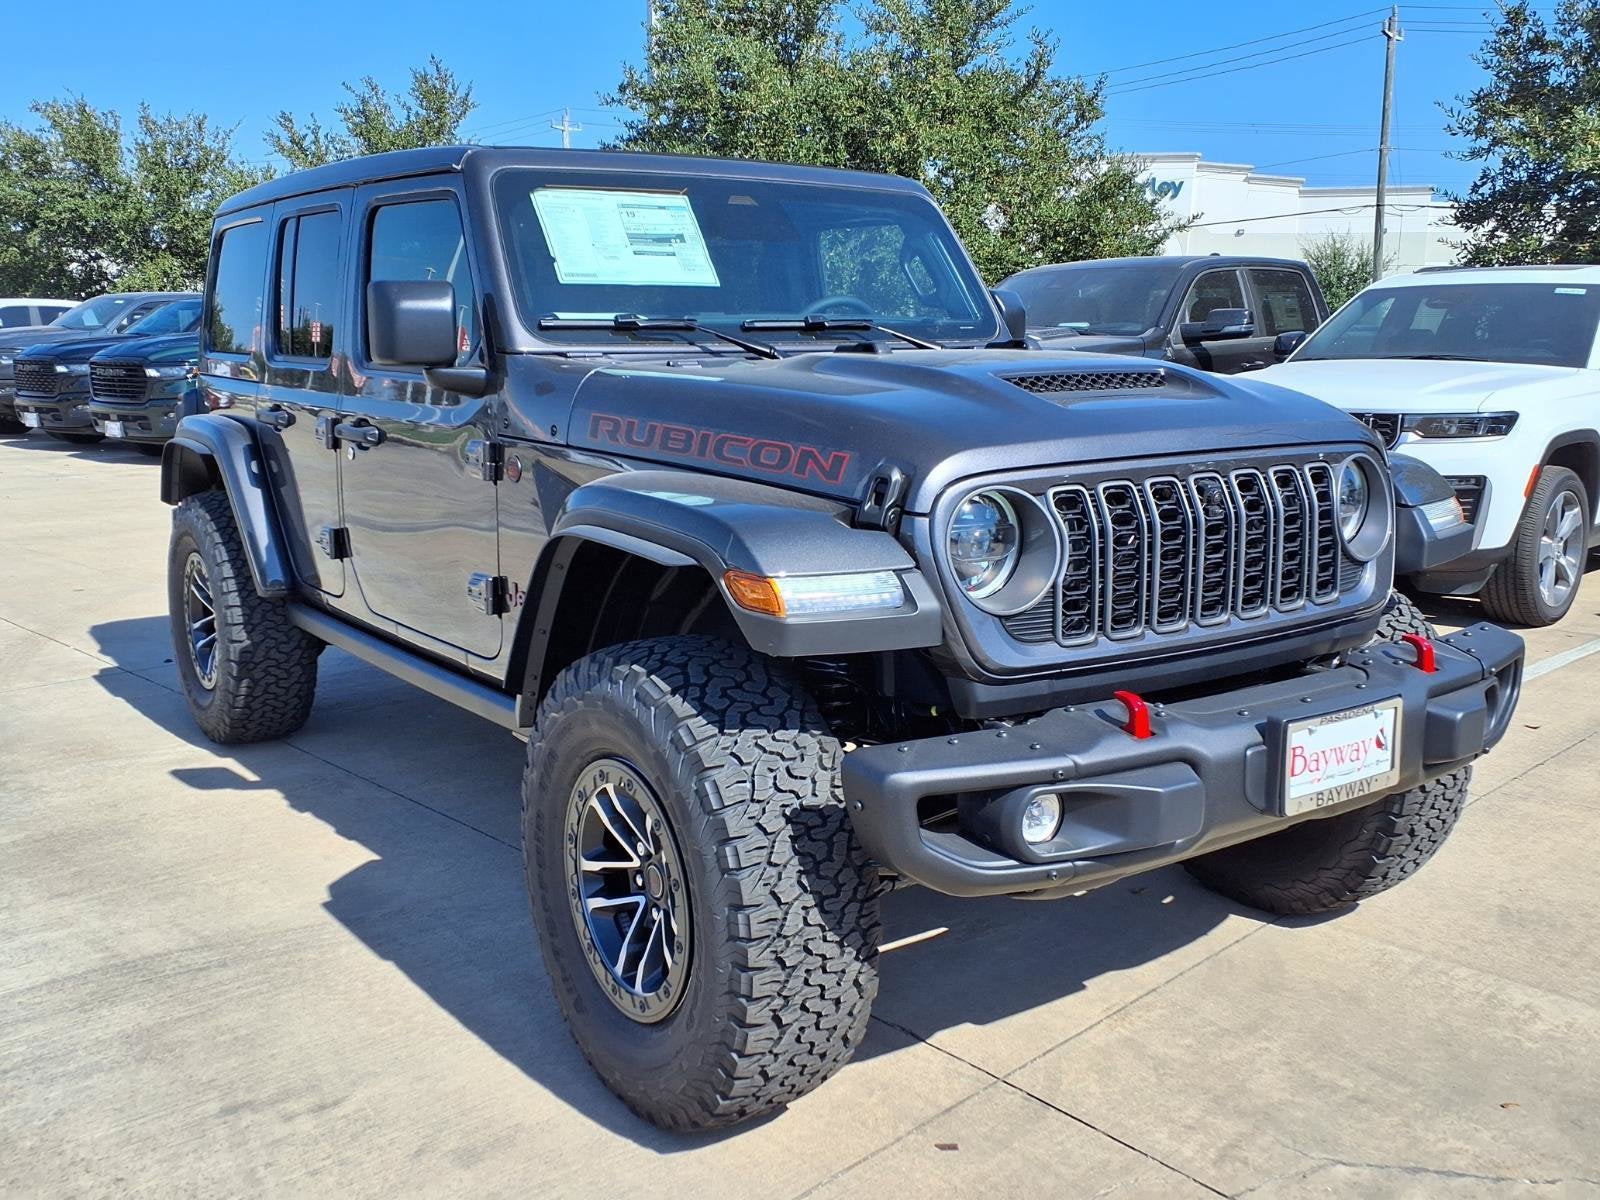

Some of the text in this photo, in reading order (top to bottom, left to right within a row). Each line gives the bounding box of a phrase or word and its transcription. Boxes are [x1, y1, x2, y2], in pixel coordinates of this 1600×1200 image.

[1150, 177, 1185, 200] ley
[588, 413, 850, 484] RUBICON
[1319, 705, 1375, 724] PASADENA
[1290, 737, 1373, 778] Bayway
[1316, 778, 1373, 807] BAYWAY
